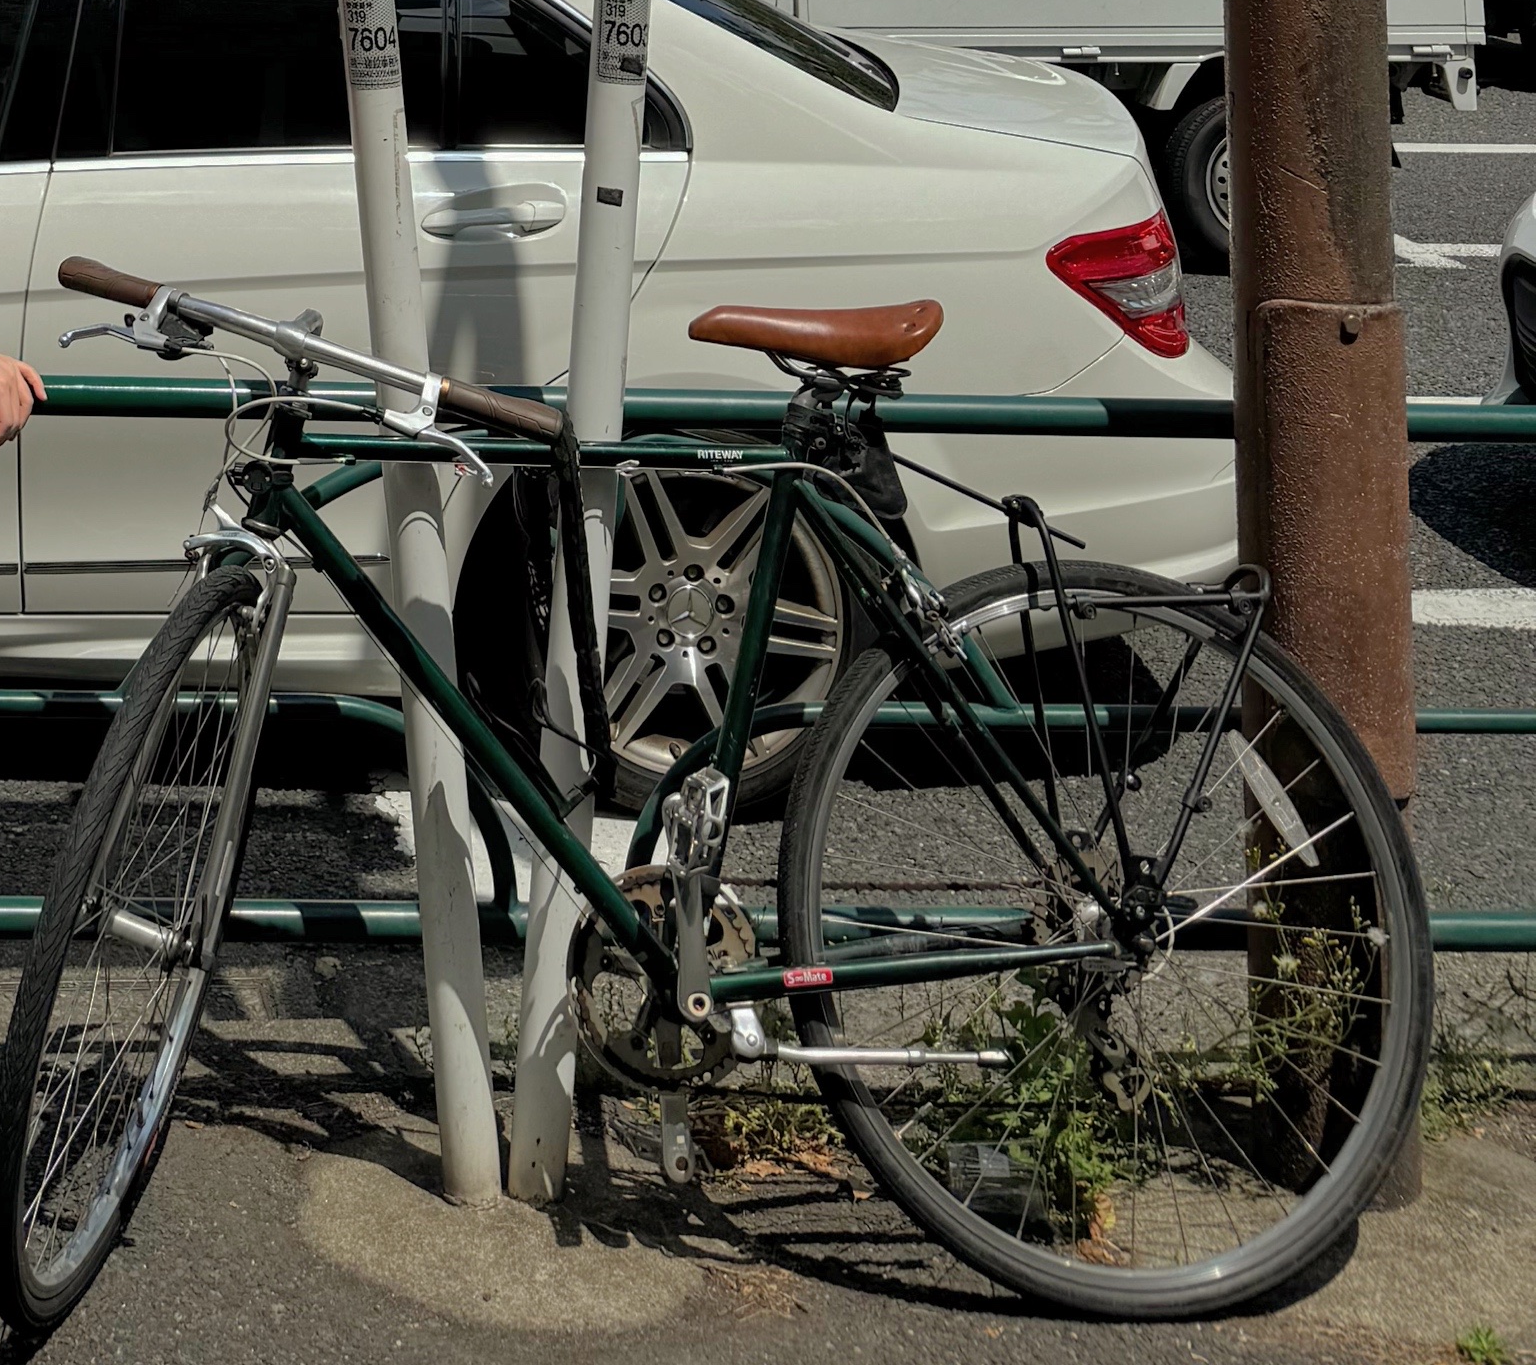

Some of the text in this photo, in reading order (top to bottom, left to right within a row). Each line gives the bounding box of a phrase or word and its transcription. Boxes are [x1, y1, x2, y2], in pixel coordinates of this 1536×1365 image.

[348, 10, 367, 24] 319
[605, 4, 626, 18] 319
[348, 26, 396, 52] 7604
[697, 449, 744, 460] RITEWAY
